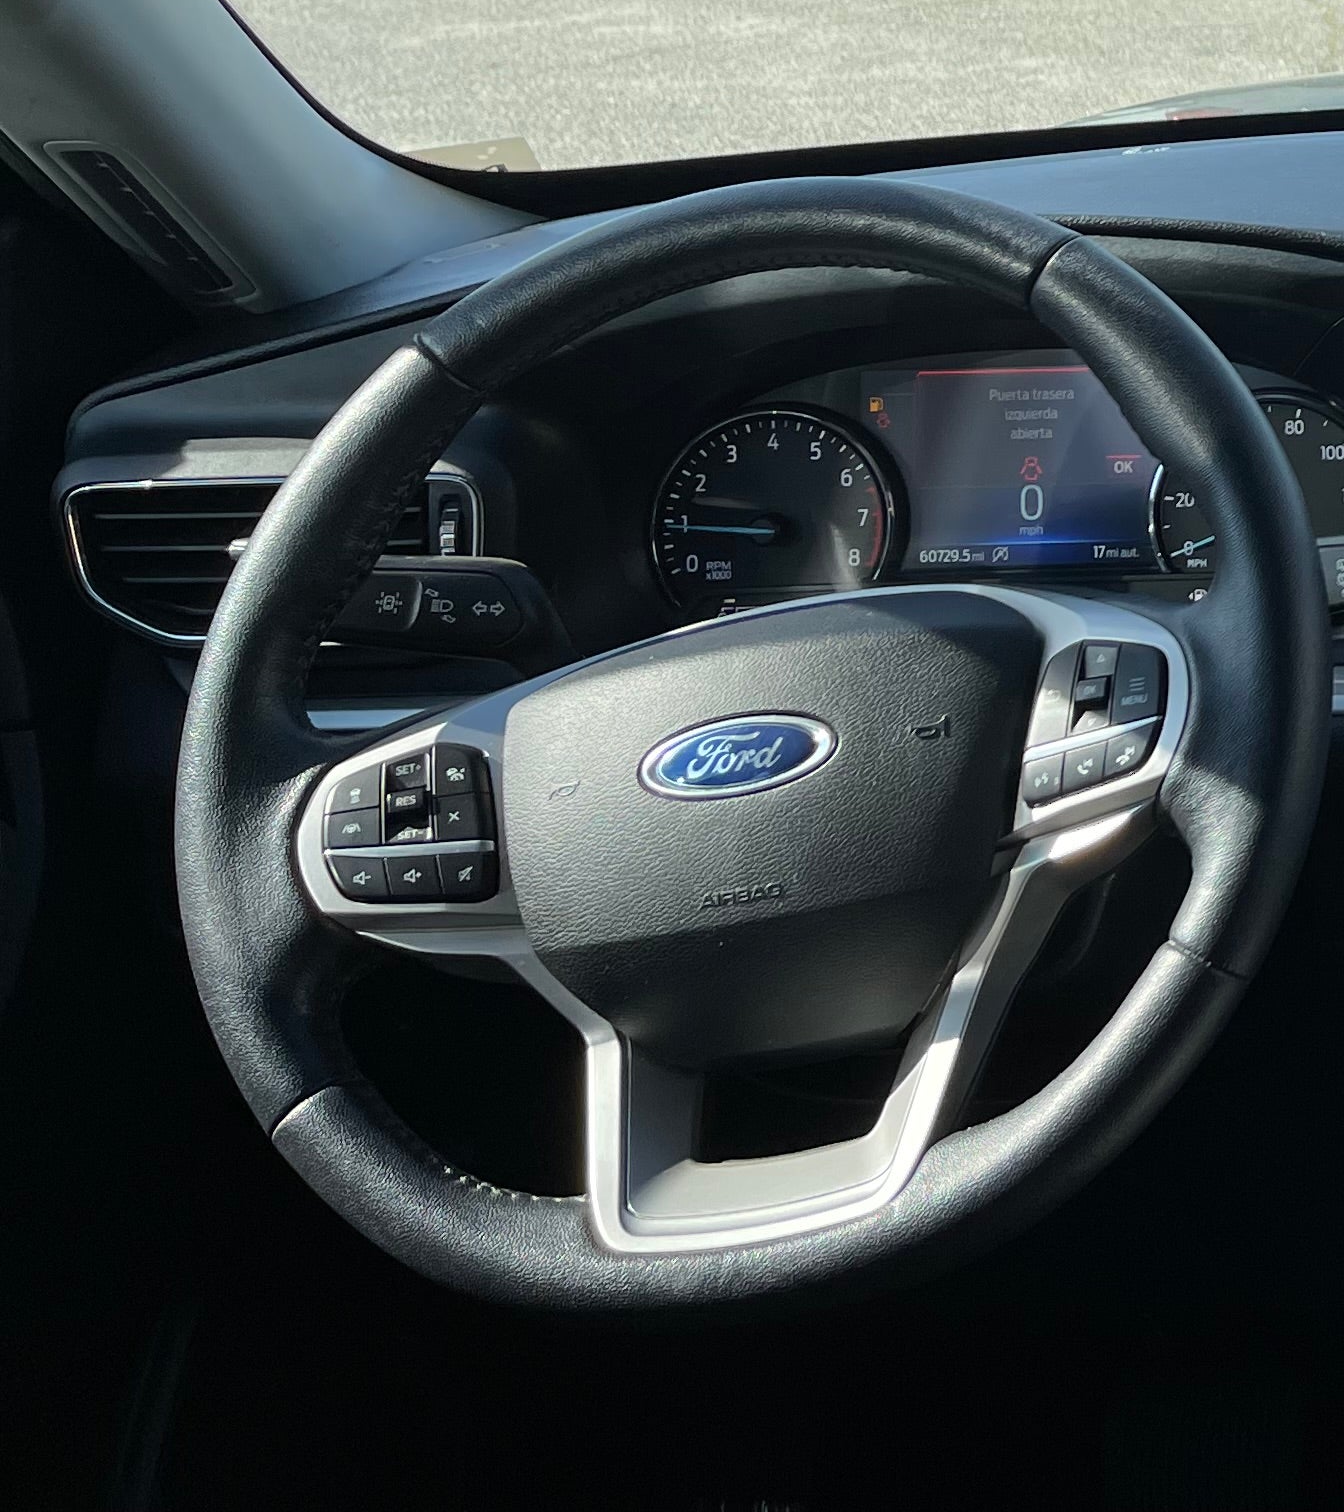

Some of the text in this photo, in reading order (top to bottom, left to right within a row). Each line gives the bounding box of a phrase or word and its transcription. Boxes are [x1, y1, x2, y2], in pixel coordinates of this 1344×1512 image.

[989, 388, 1075, 401] Puerta trasera
[1004, 407, 1058, 422] izquierda
[1010, 427, 1053, 440] abierta
[1284, 419, 1305, 435] 80
[767, 433, 779, 450] 4
[726, 445, 737, 463] 3
[810, 442, 822, 461] 5
[1113, 460, 1133, 474] OK
[695, 474, 706, 492] 2
[840, 468, 853, 487] 6
[1019, 484, 1044, 521] 0
[1175, 492, 1195, 508] 20
[857, 508, 869, 527] 7
[1019, 525, 1044, 536] mph
[849, 548, 860, 567] 8
[1092, 545, 1105, 559] 17
[1120, 548, 1140, 558] aut.
[686, 555, 698, 573] 0
[706, 561, 732, 571] RPM
[1186, 558, 1208, 568] MPH
[705, 571, 732, 580] x1000
[1121, 693, 1148, 706] MENU
[687, 729, 784, 784] Ford
[395, 794, 417, 807] RES
[701, 881, 784, 909] AIRBAG
